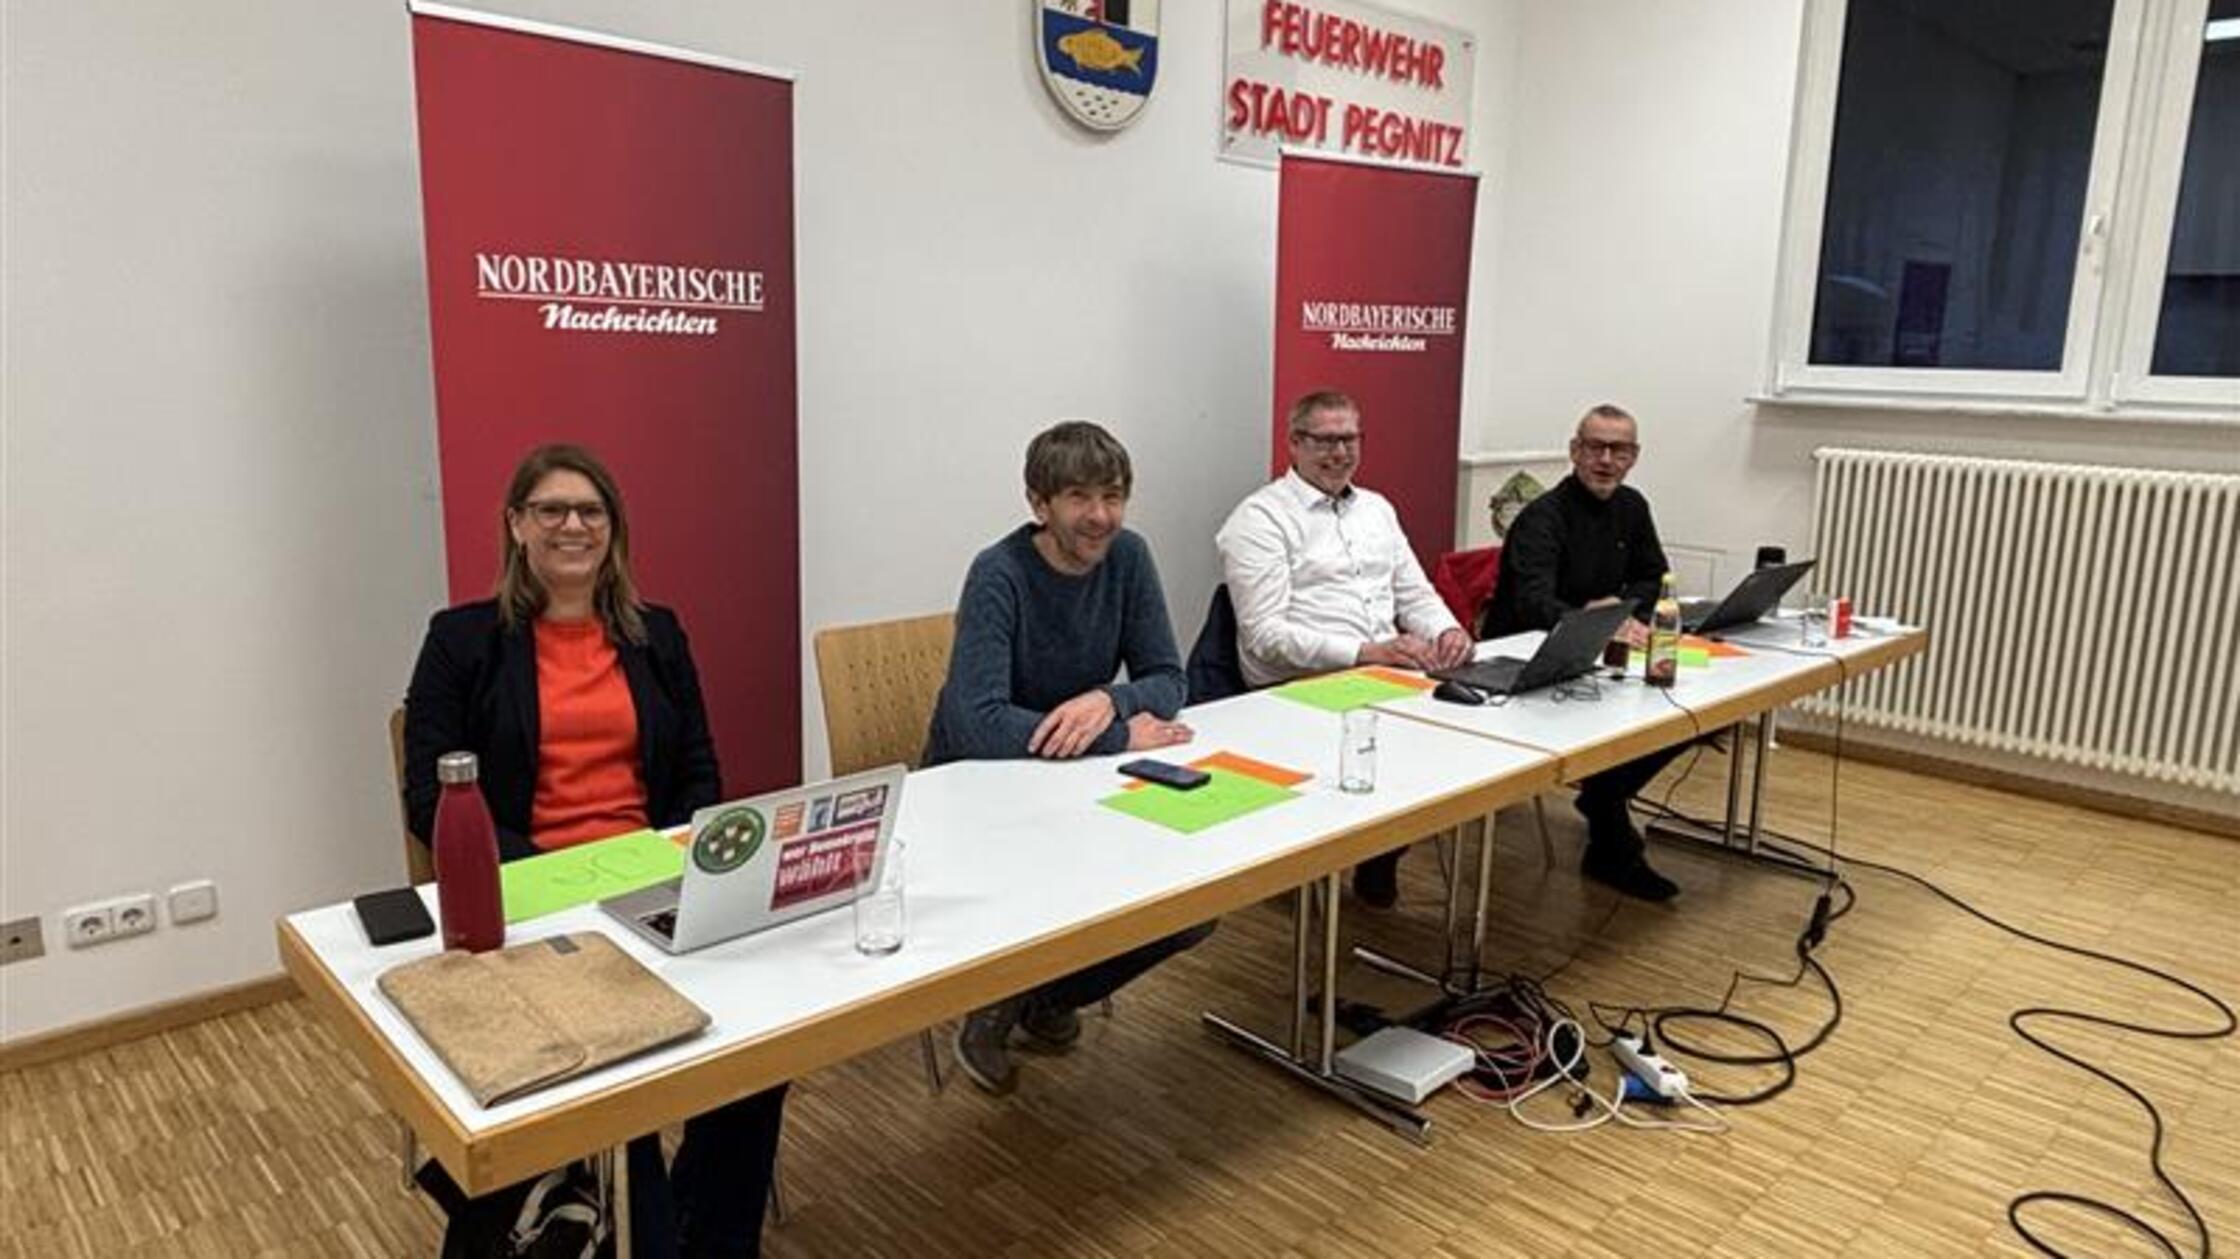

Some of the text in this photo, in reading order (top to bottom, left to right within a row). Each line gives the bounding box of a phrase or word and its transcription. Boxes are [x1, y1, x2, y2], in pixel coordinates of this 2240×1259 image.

[1261, 1, 1445, 90] FEUERWEHR
[1228, 78, 1464, 167] STADT PEGNITZ
[476, 253, 764, 304] NORDBAYERISCHE
[538, 302, 718, 335] Nachrichten
[1302, 301, 1456, 330] NORDBAYERISCHE
[1329, 332, 1426, 351] Nachrichten
